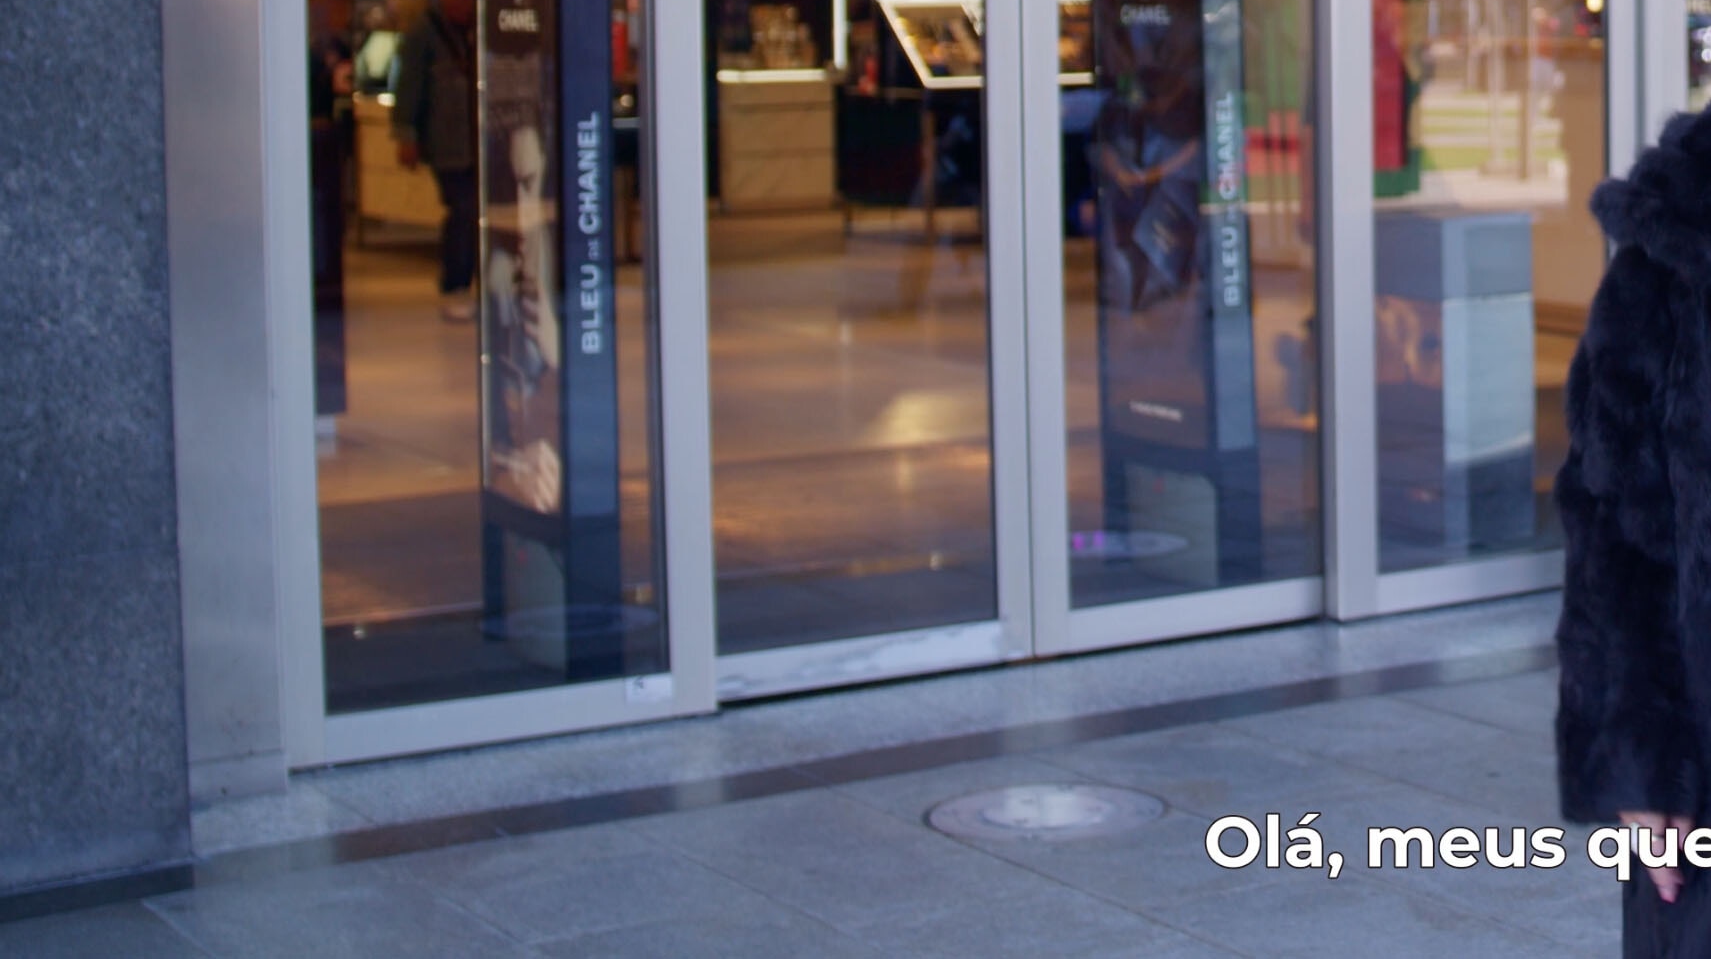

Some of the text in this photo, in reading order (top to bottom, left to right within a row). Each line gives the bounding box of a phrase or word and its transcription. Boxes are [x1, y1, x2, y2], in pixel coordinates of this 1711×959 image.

[577, 110, 600, 236] CHANEL
[1215, 90, 1238, 202] CHANEL
[580, 263, 600, 355] BLEU
[1221, 226, 1241, 307] BLEU
